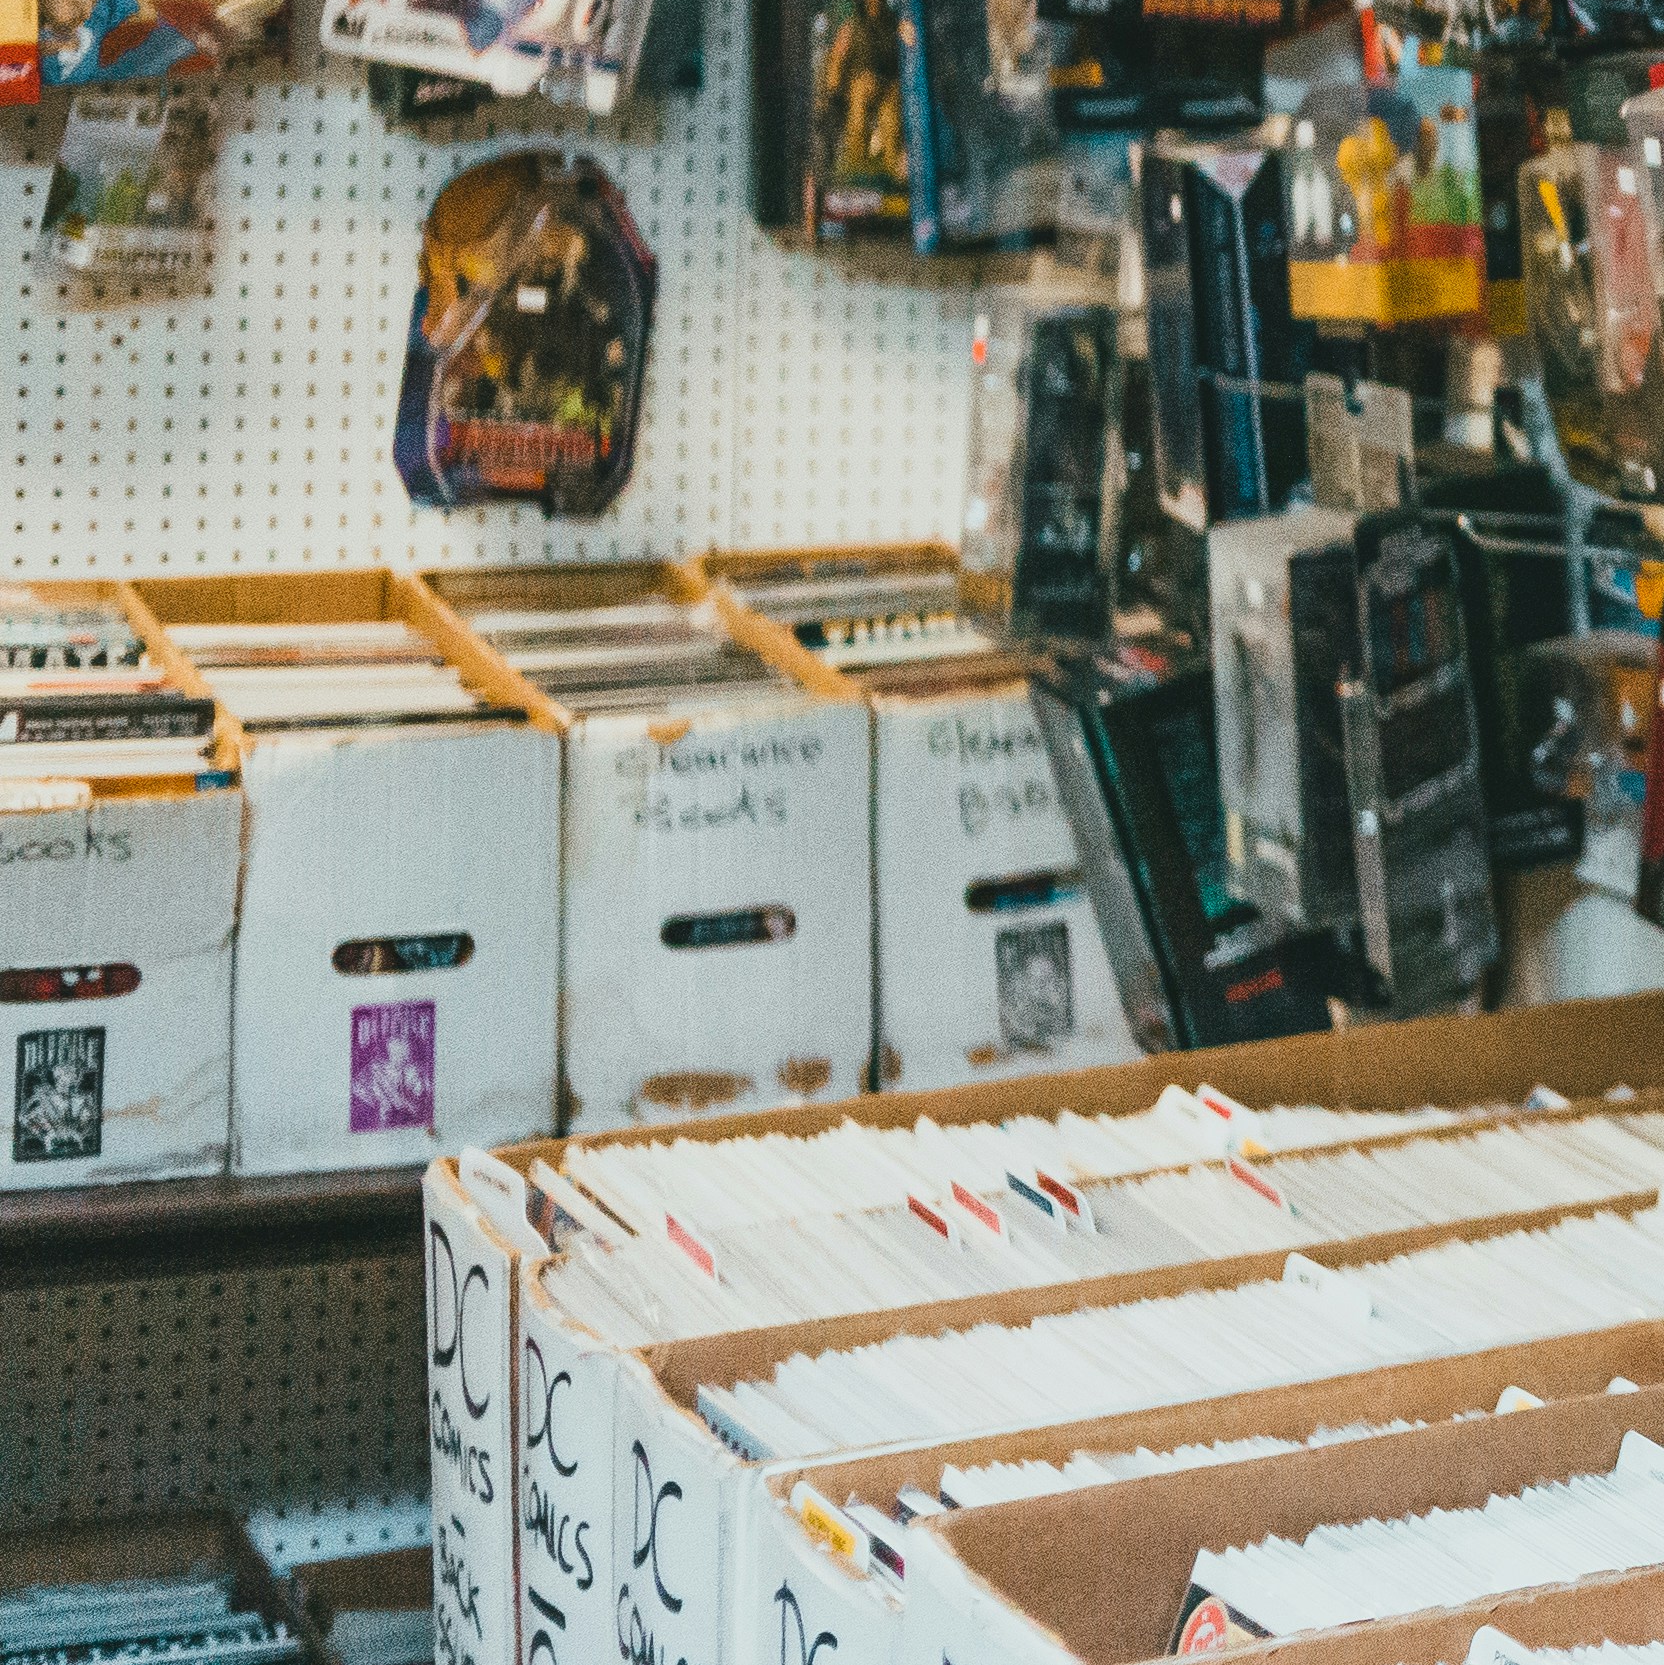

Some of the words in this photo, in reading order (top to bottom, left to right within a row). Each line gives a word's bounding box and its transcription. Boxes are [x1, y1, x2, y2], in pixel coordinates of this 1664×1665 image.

[429, 1219, 491, 1421] DC
[525, 1337, 579, 1478] DC
[630, 1438, 683, 1613] DC
